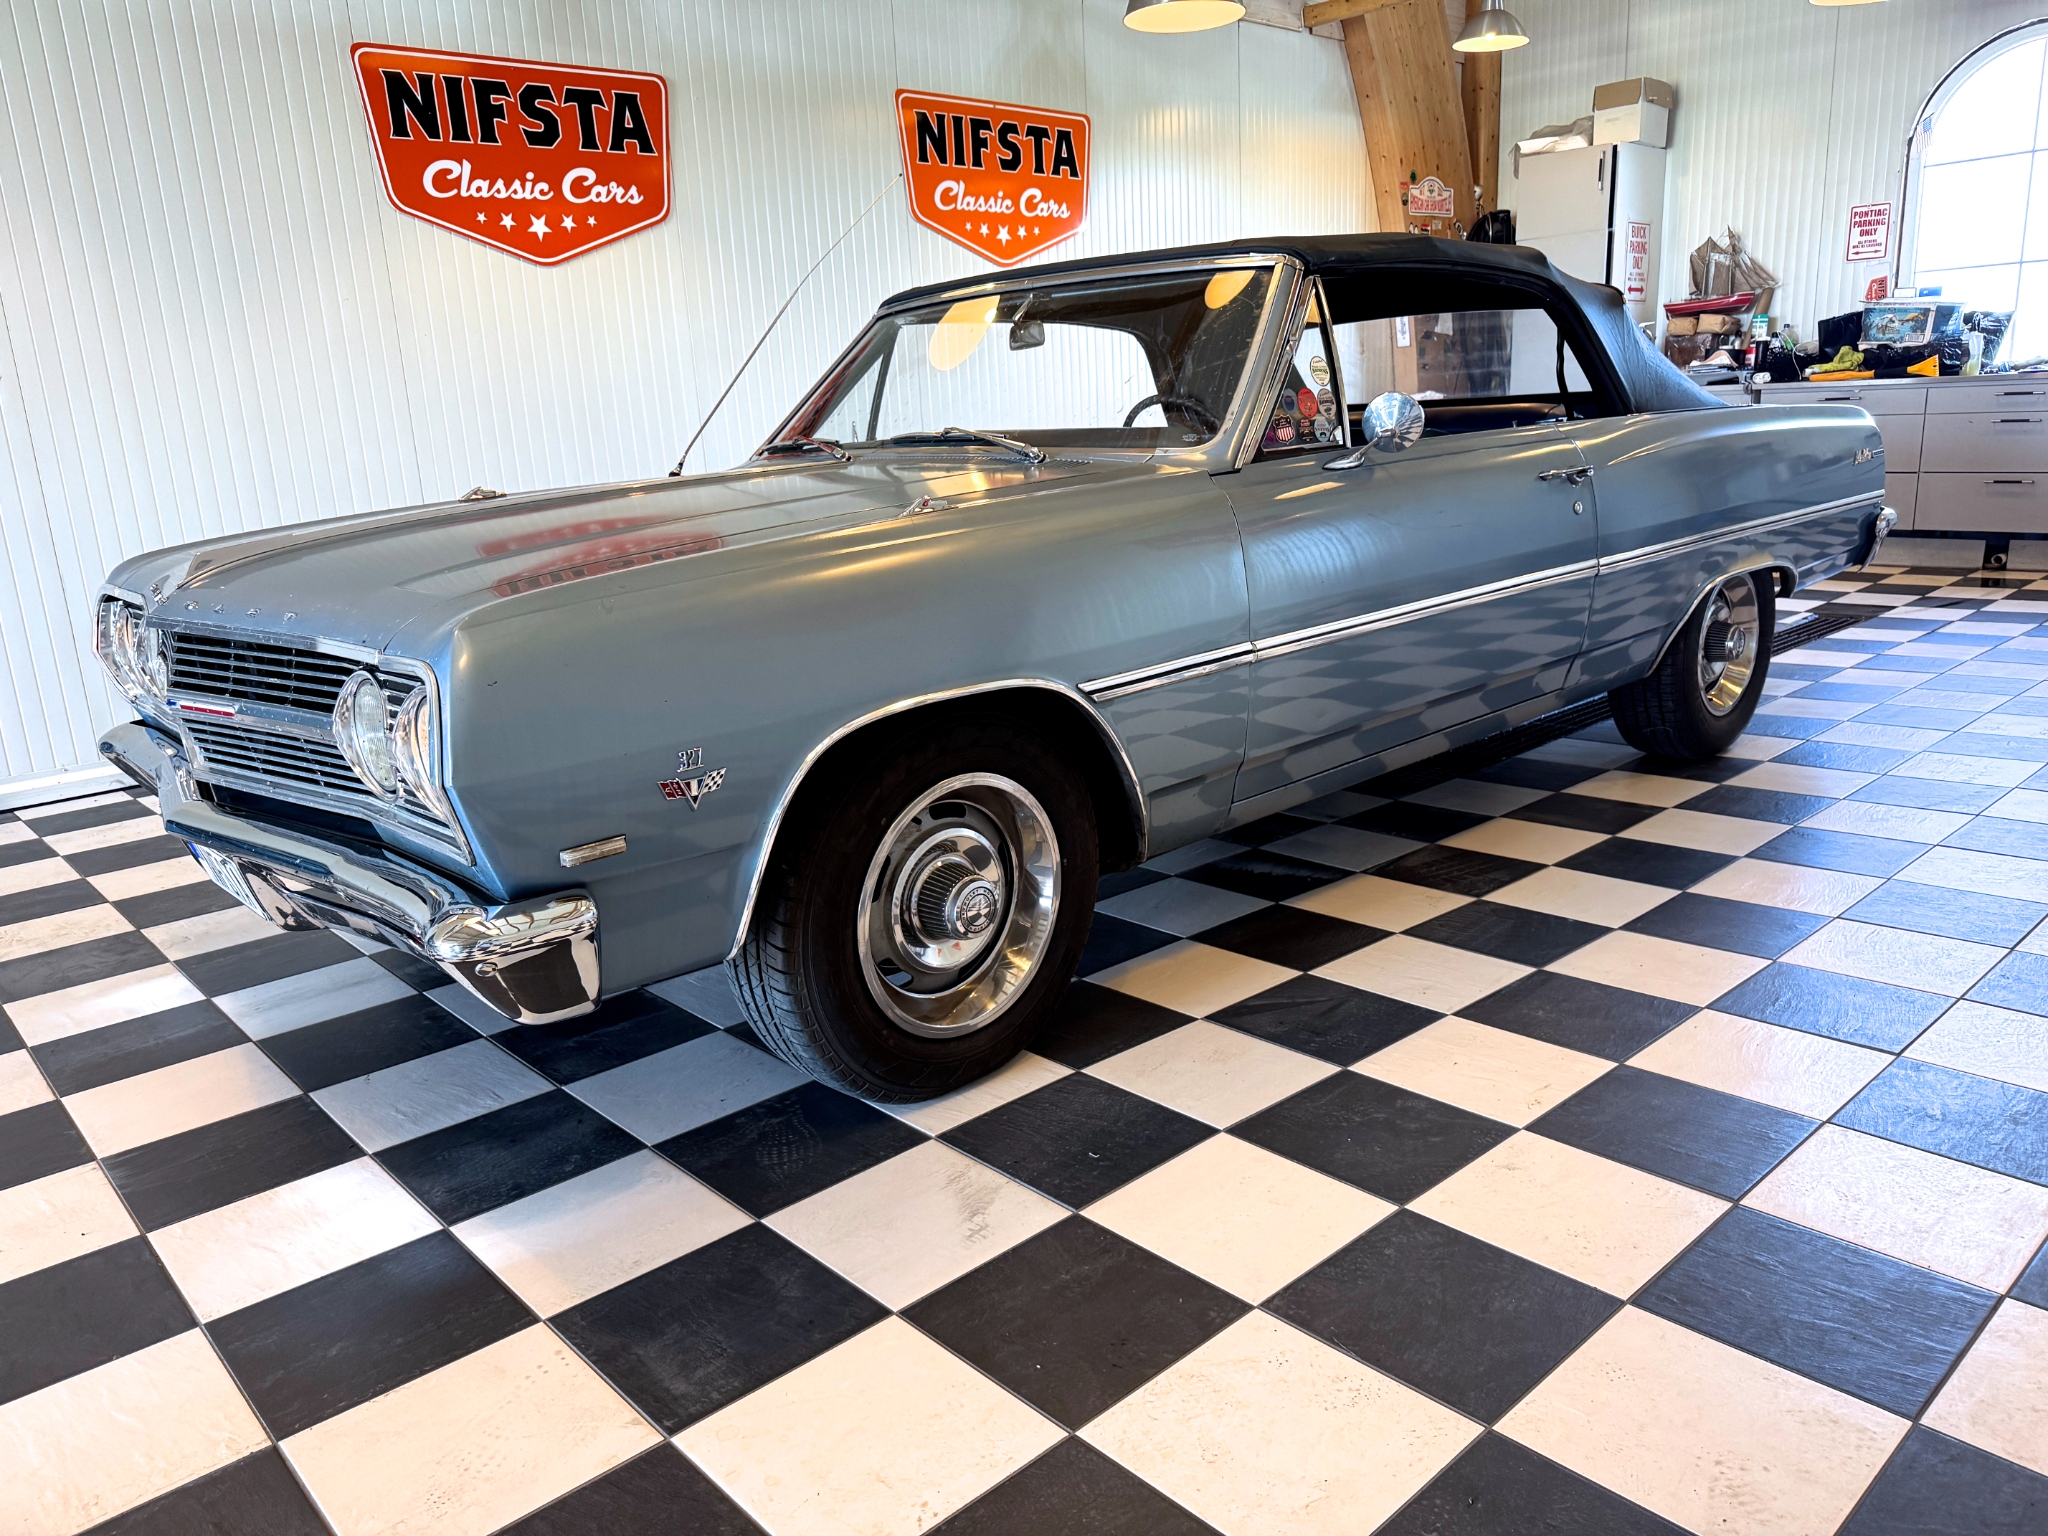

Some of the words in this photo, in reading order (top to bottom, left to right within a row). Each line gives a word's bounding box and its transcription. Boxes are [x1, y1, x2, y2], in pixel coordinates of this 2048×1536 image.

[378, 67, 659, 157] NIFSTA
[913, 108, 1082, 181] NIFSTA
[422, 158, 554, 201] Classic
[561, 167, 644, 205] Cars
[934, 180, 1015, 214] Classic
[1019, 187, 1071, 219] Cars
[1853, 208, 1888, 220] PONTIAC
[1853, 217, 1886, 229] PARKING
[1631, 225, 1647, 239] BUICK
[1859, 227, 1878, 237] ONLY
[1629, 241, 1647, 255] PARKING
[1632, 256, 1643, 269] ONLY
[1877, 279, 1885, 300] NIFS
[677, 747, 704, 772] 327
